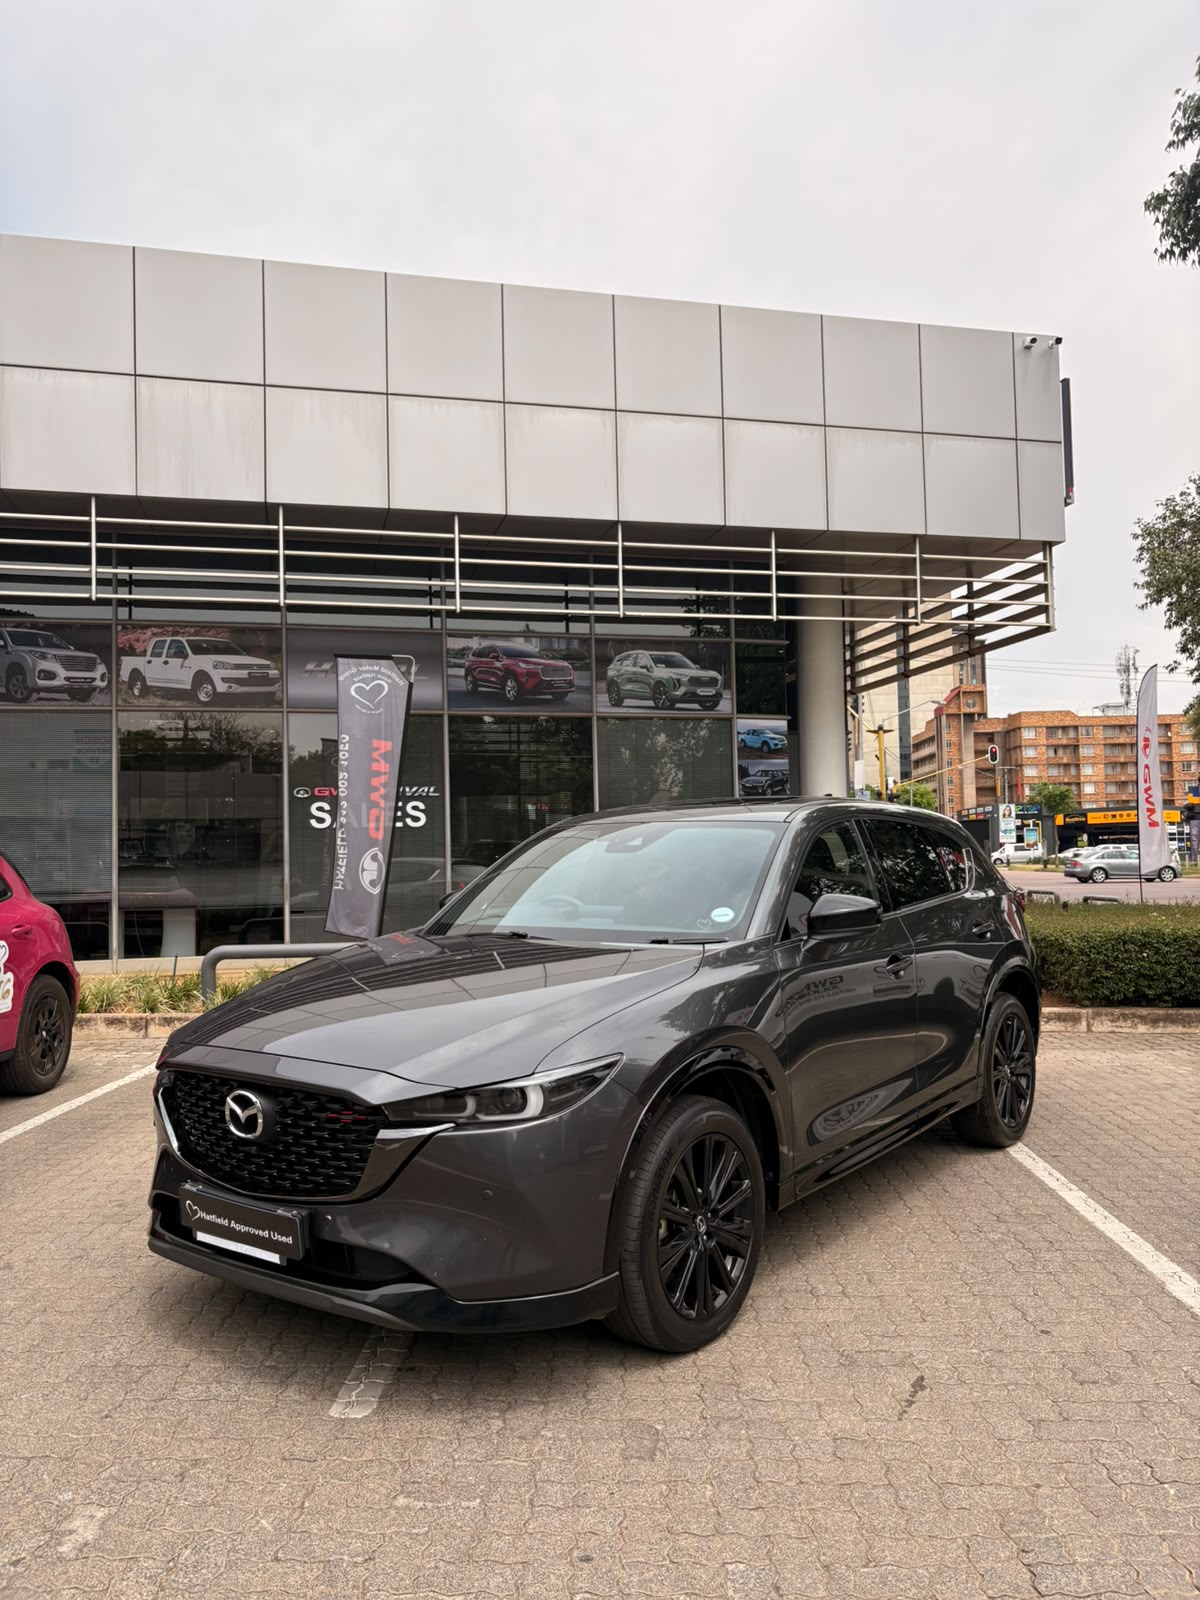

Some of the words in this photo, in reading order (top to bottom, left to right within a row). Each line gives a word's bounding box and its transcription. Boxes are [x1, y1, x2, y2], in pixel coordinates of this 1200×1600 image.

[1142, 764, 1160, 828] GWM
[200, 1211, 229, 1227] Hatfield
[230, 1220, 269, 1238] Approved
[271, 1231, 293, 1244] Used
